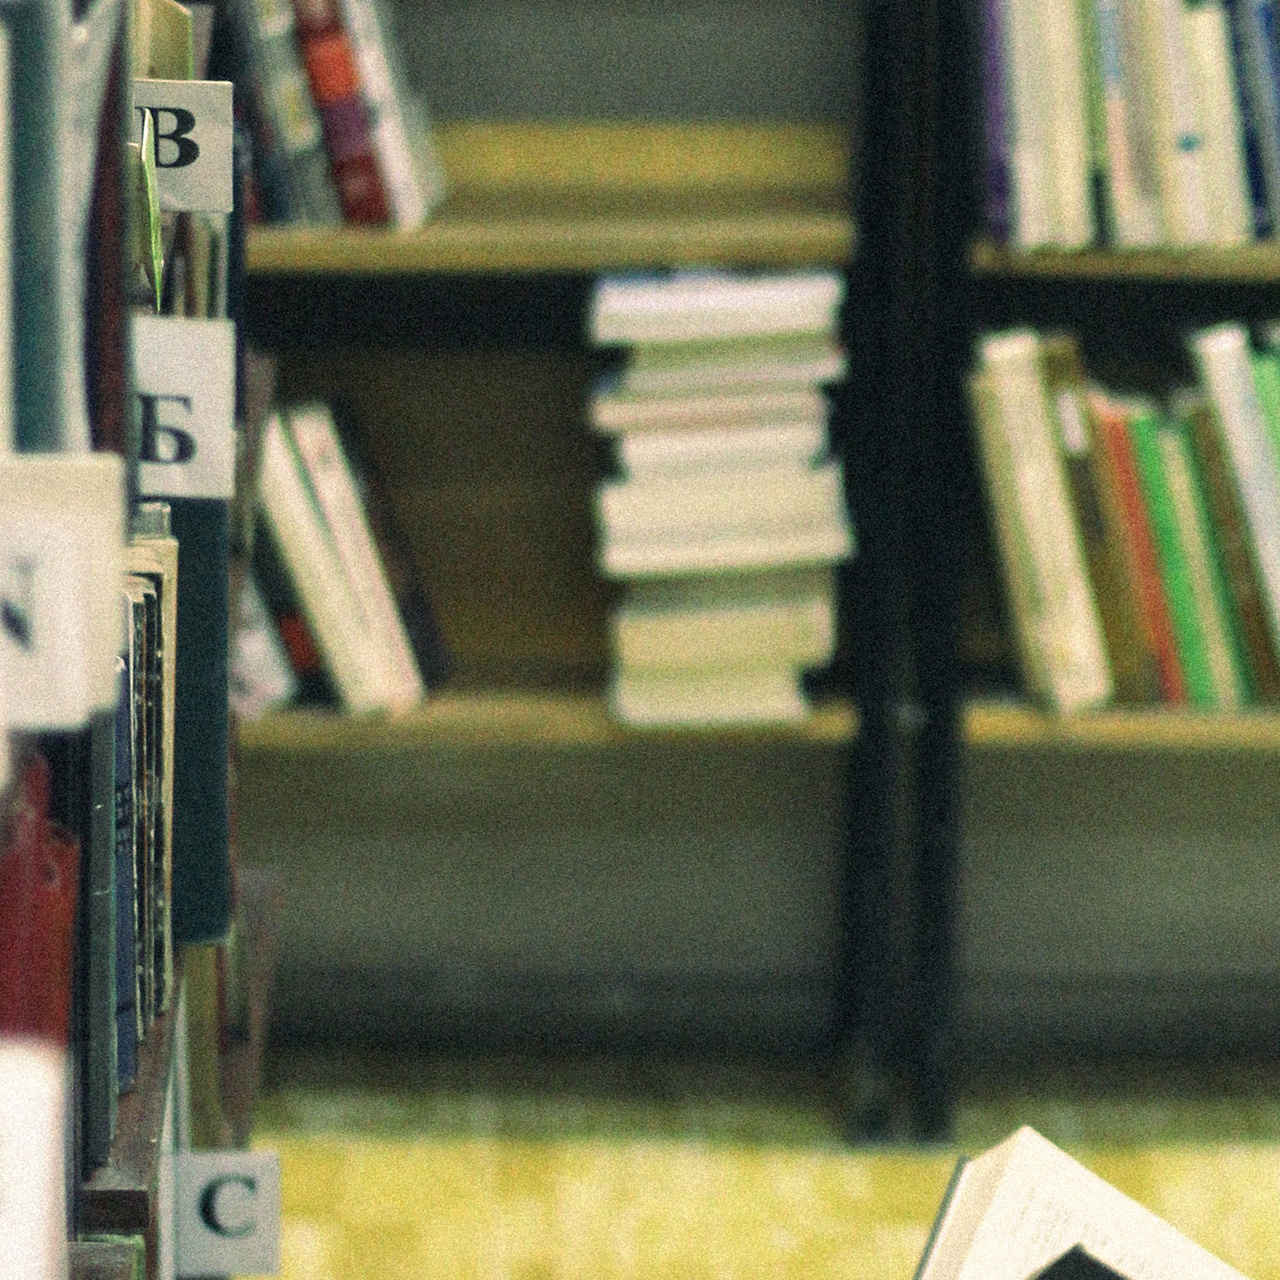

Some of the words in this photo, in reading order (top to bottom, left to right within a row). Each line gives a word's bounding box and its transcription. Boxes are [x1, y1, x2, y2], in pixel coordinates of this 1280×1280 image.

[136, 106, 200, 170] В
[139, 392, 197, 466] Б
[197, 1175, 256, 1237] С
